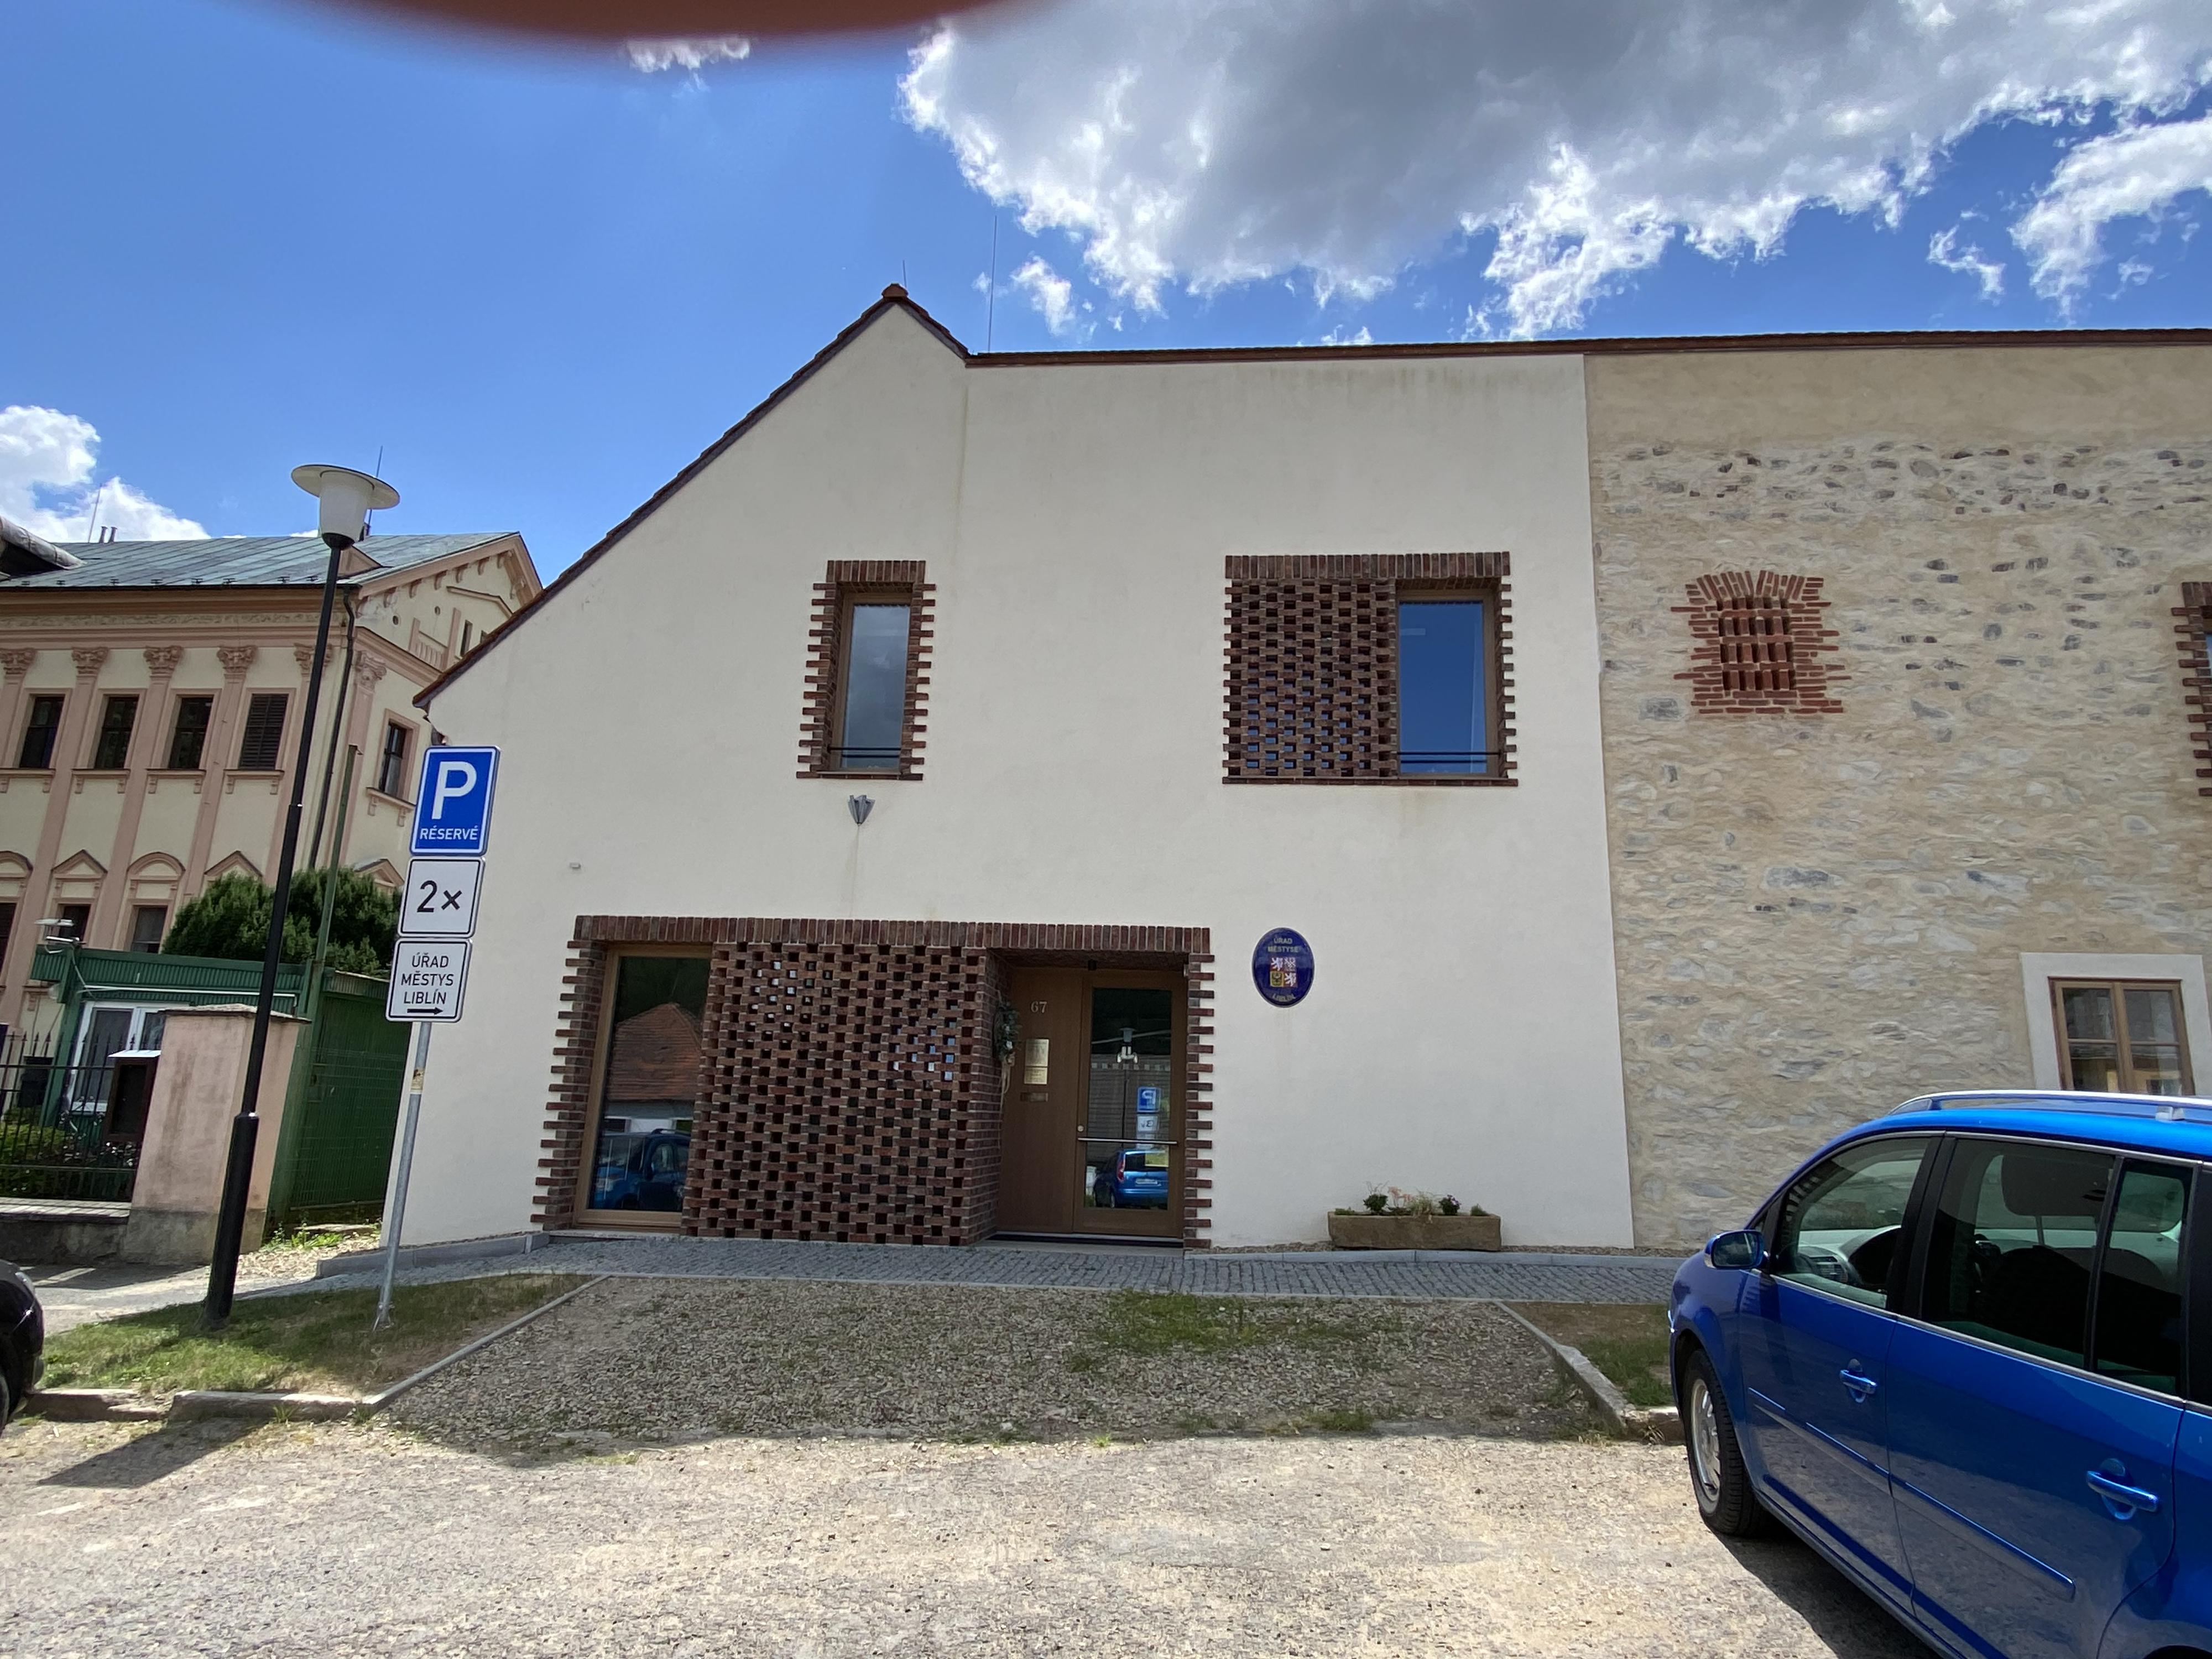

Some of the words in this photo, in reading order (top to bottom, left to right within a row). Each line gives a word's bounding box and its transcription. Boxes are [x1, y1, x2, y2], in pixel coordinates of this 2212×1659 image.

[431, 761, 477, 820] P
[419, 825, 478, 840] RÉSERVÉ
[411, 952, 449, 968] ÚŘAD
[400, 971, 455, 986] MĚSTYS
[404, 989, 446, 1004] LIBLÍN
[1031, 1001, 1047, 1013] 67
